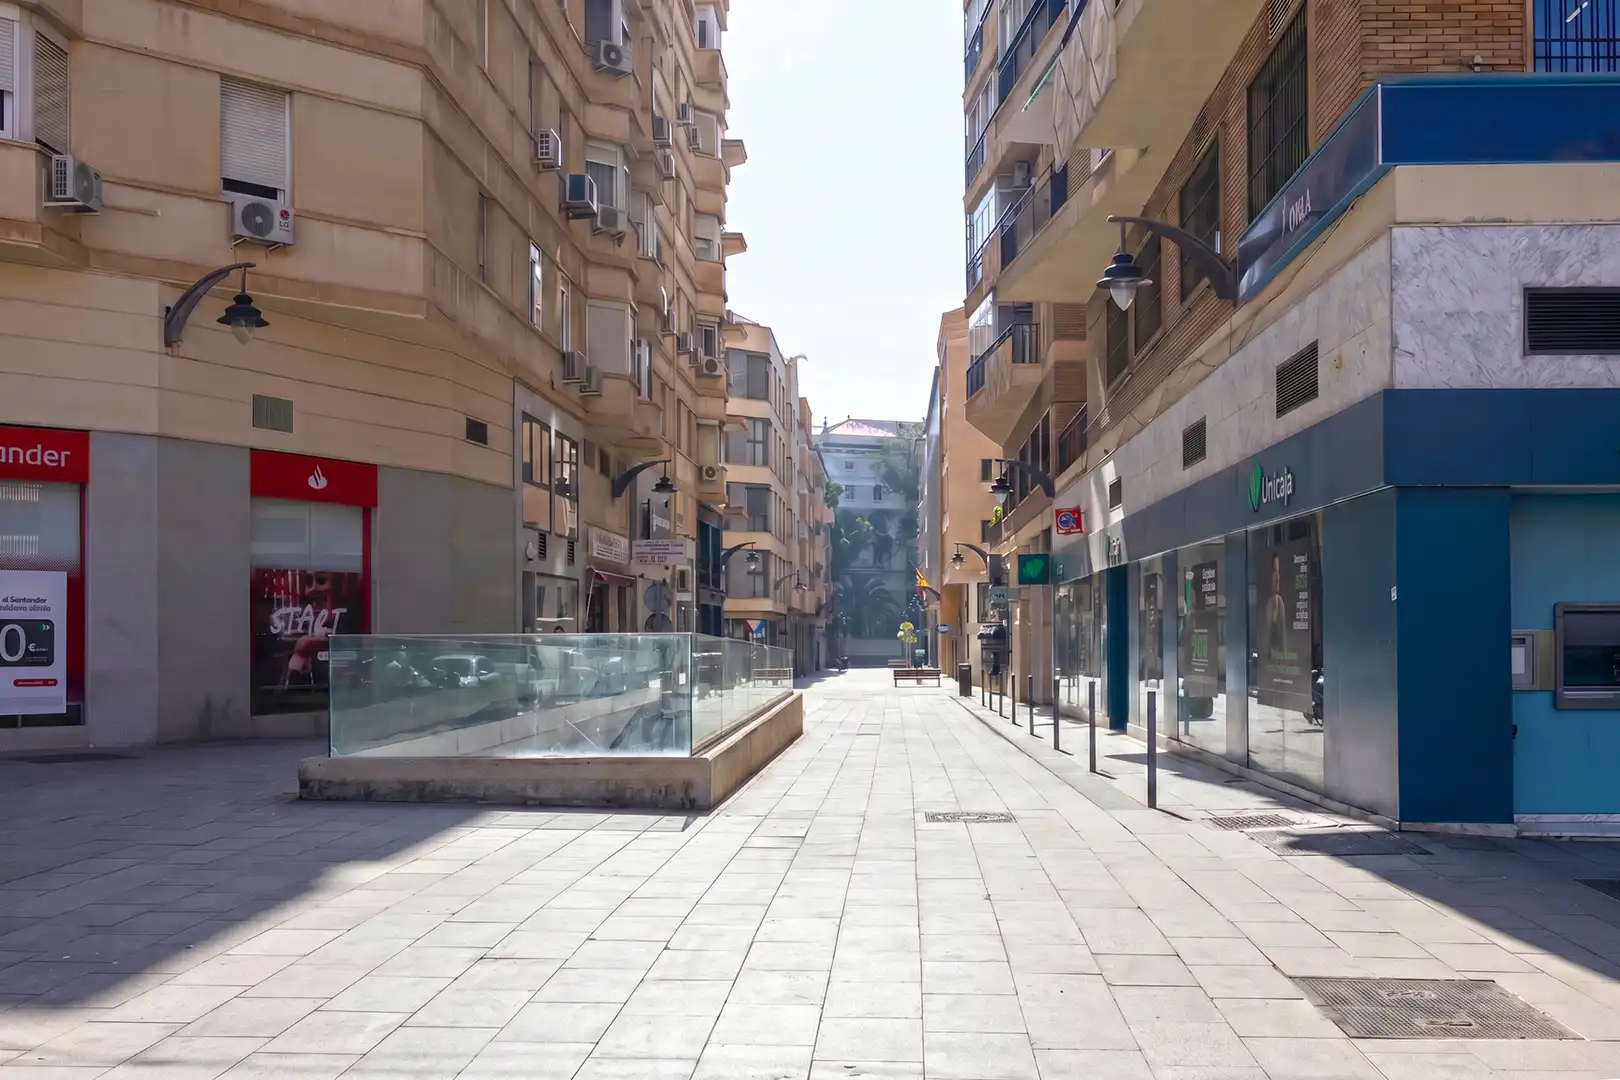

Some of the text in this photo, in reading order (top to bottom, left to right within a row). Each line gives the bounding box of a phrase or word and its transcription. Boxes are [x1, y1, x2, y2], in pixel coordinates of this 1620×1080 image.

[1262, 466, 1293, 506] Unicaja
[10, 596, 47, 604] Santander
[270, 604, 347, 636] START
